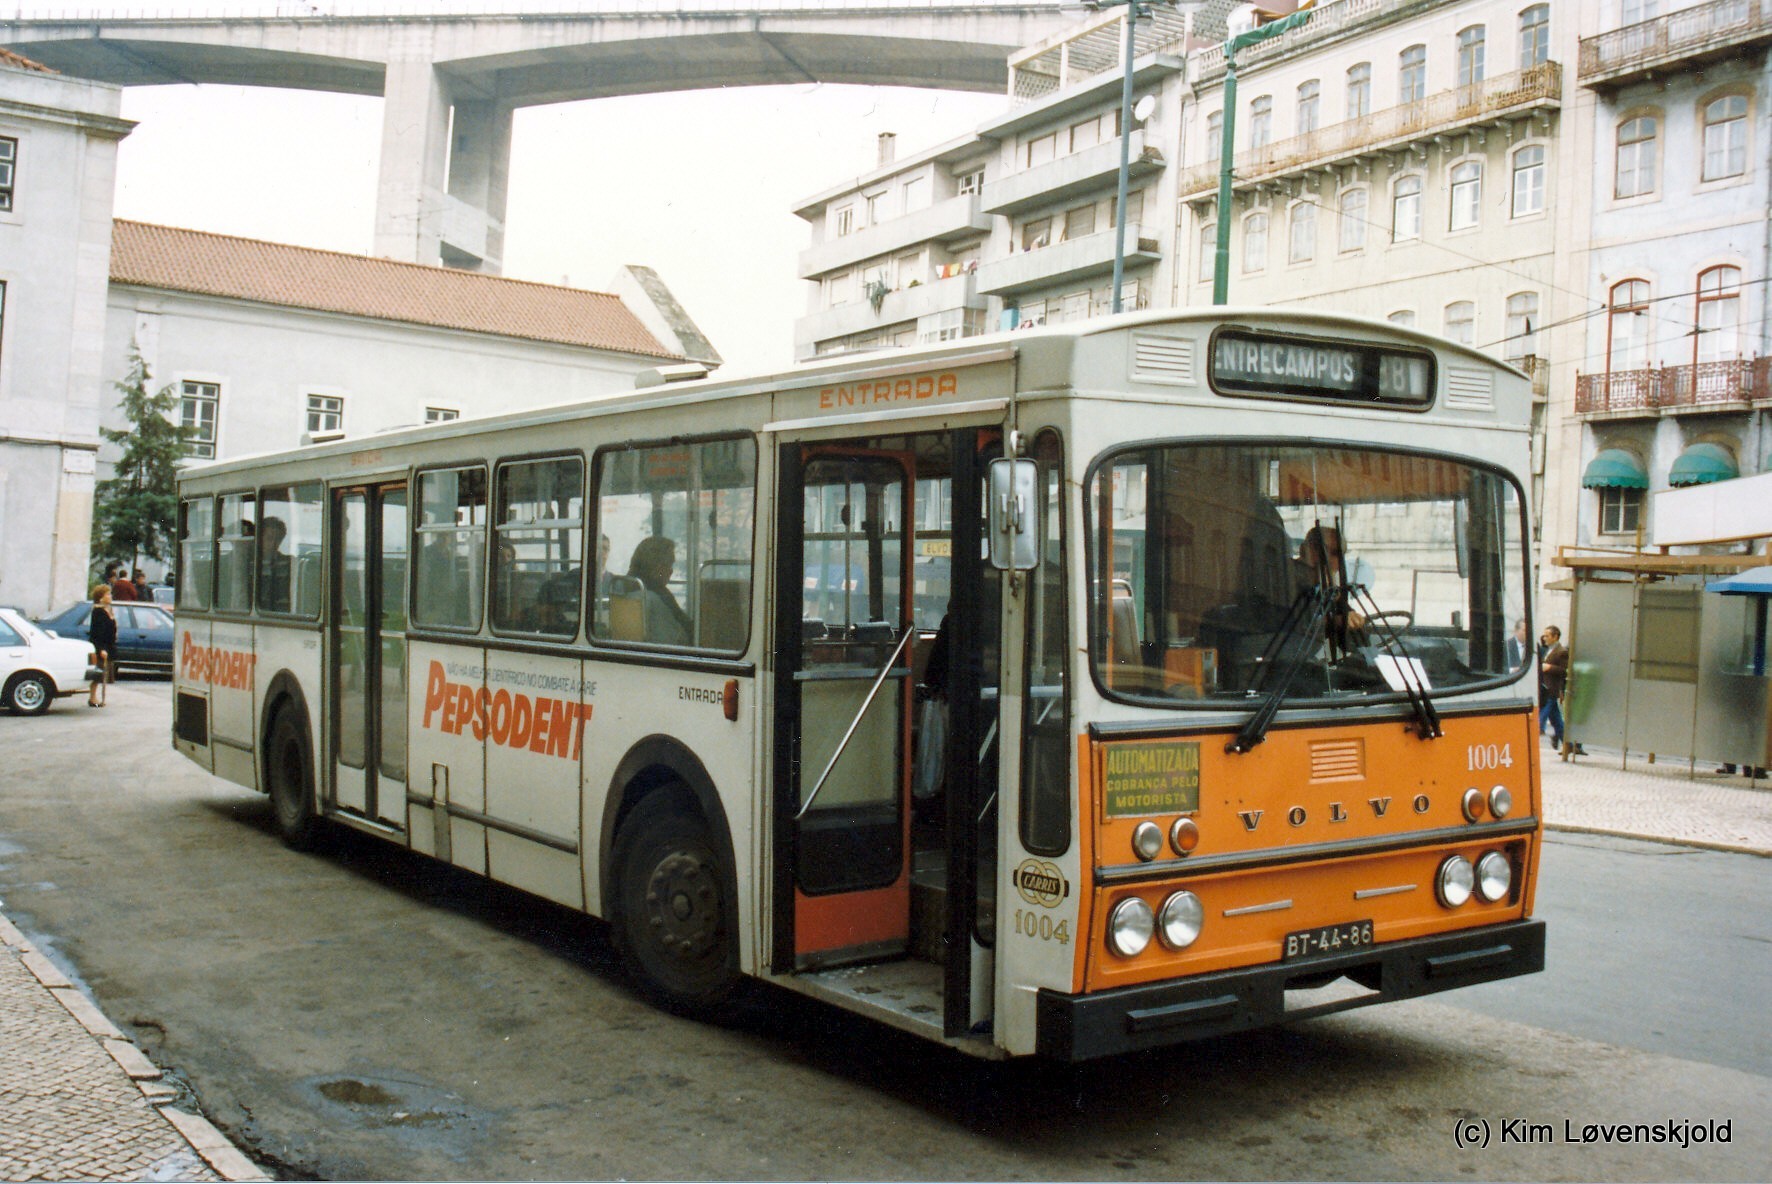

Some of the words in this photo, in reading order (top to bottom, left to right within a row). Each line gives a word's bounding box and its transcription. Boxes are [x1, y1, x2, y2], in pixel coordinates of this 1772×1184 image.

[819, 373, 957, 409] ENTRADA
[181, 630, 257, 692] PEPSODENT
[422, 660, 594, 761] PEPSODENT
[678, 686, 724, 705] ENTRADA
[1108, 748, 1199, 774] AUTOMATIZADA
[1467, 743, 1513, 771] 1004
[1172, 775, 1198, 788] PELO
[1116, 793, 1188, 807] MOTORISTA
[1238, 794, 1431, 831] VOLVO
[1023, 875, 1058, 893] CARRIS
[1015, 908, 1069, 945] 1004
[1287, 924, 1372, 957] BT-44-86
